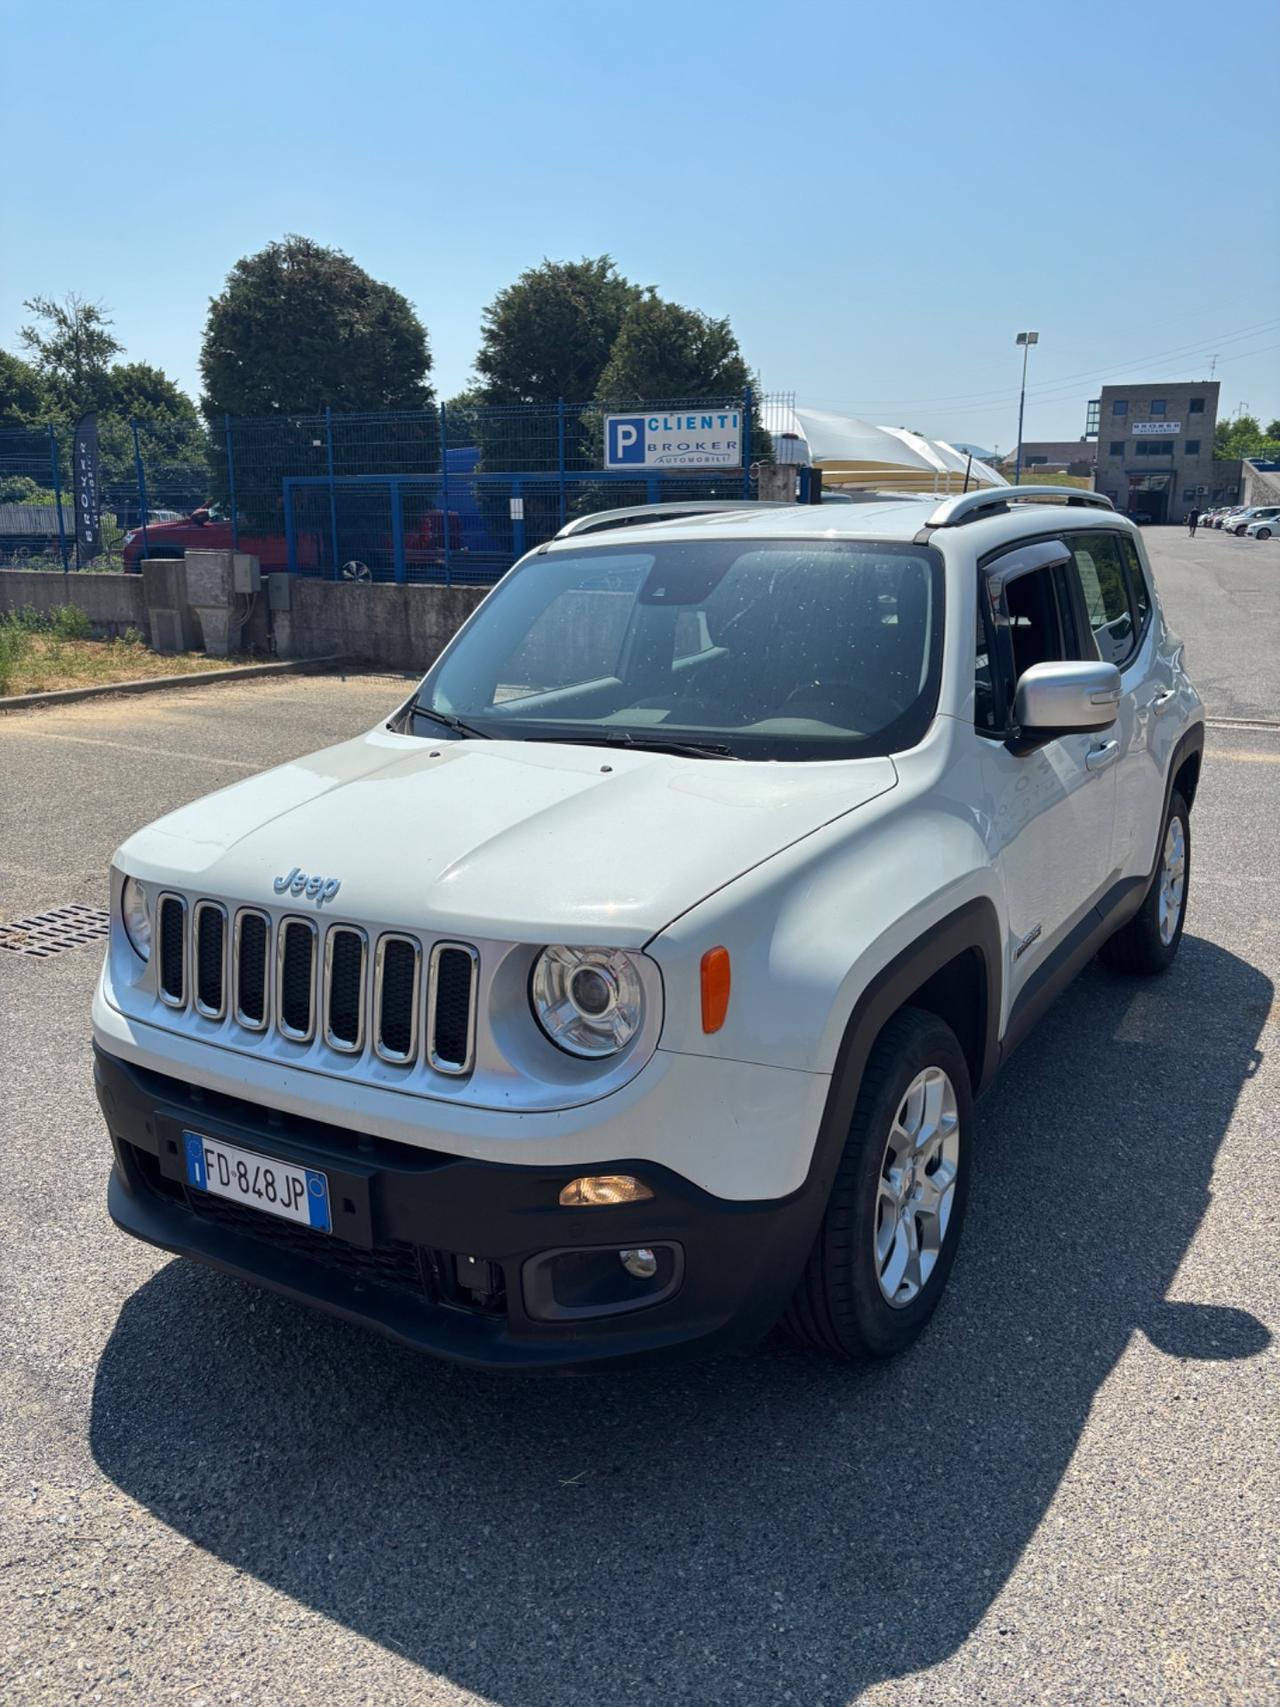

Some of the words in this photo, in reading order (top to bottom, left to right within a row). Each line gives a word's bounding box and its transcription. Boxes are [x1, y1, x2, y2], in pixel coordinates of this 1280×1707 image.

[647, 414, 738, 432] CLIENTI
[616, 424, 638, 459] P
[647, 441, 737, 452] BROKER
[658, 455, 727, 464] AUTOMOBILI
[273, 867, 342, 908] Jeep
